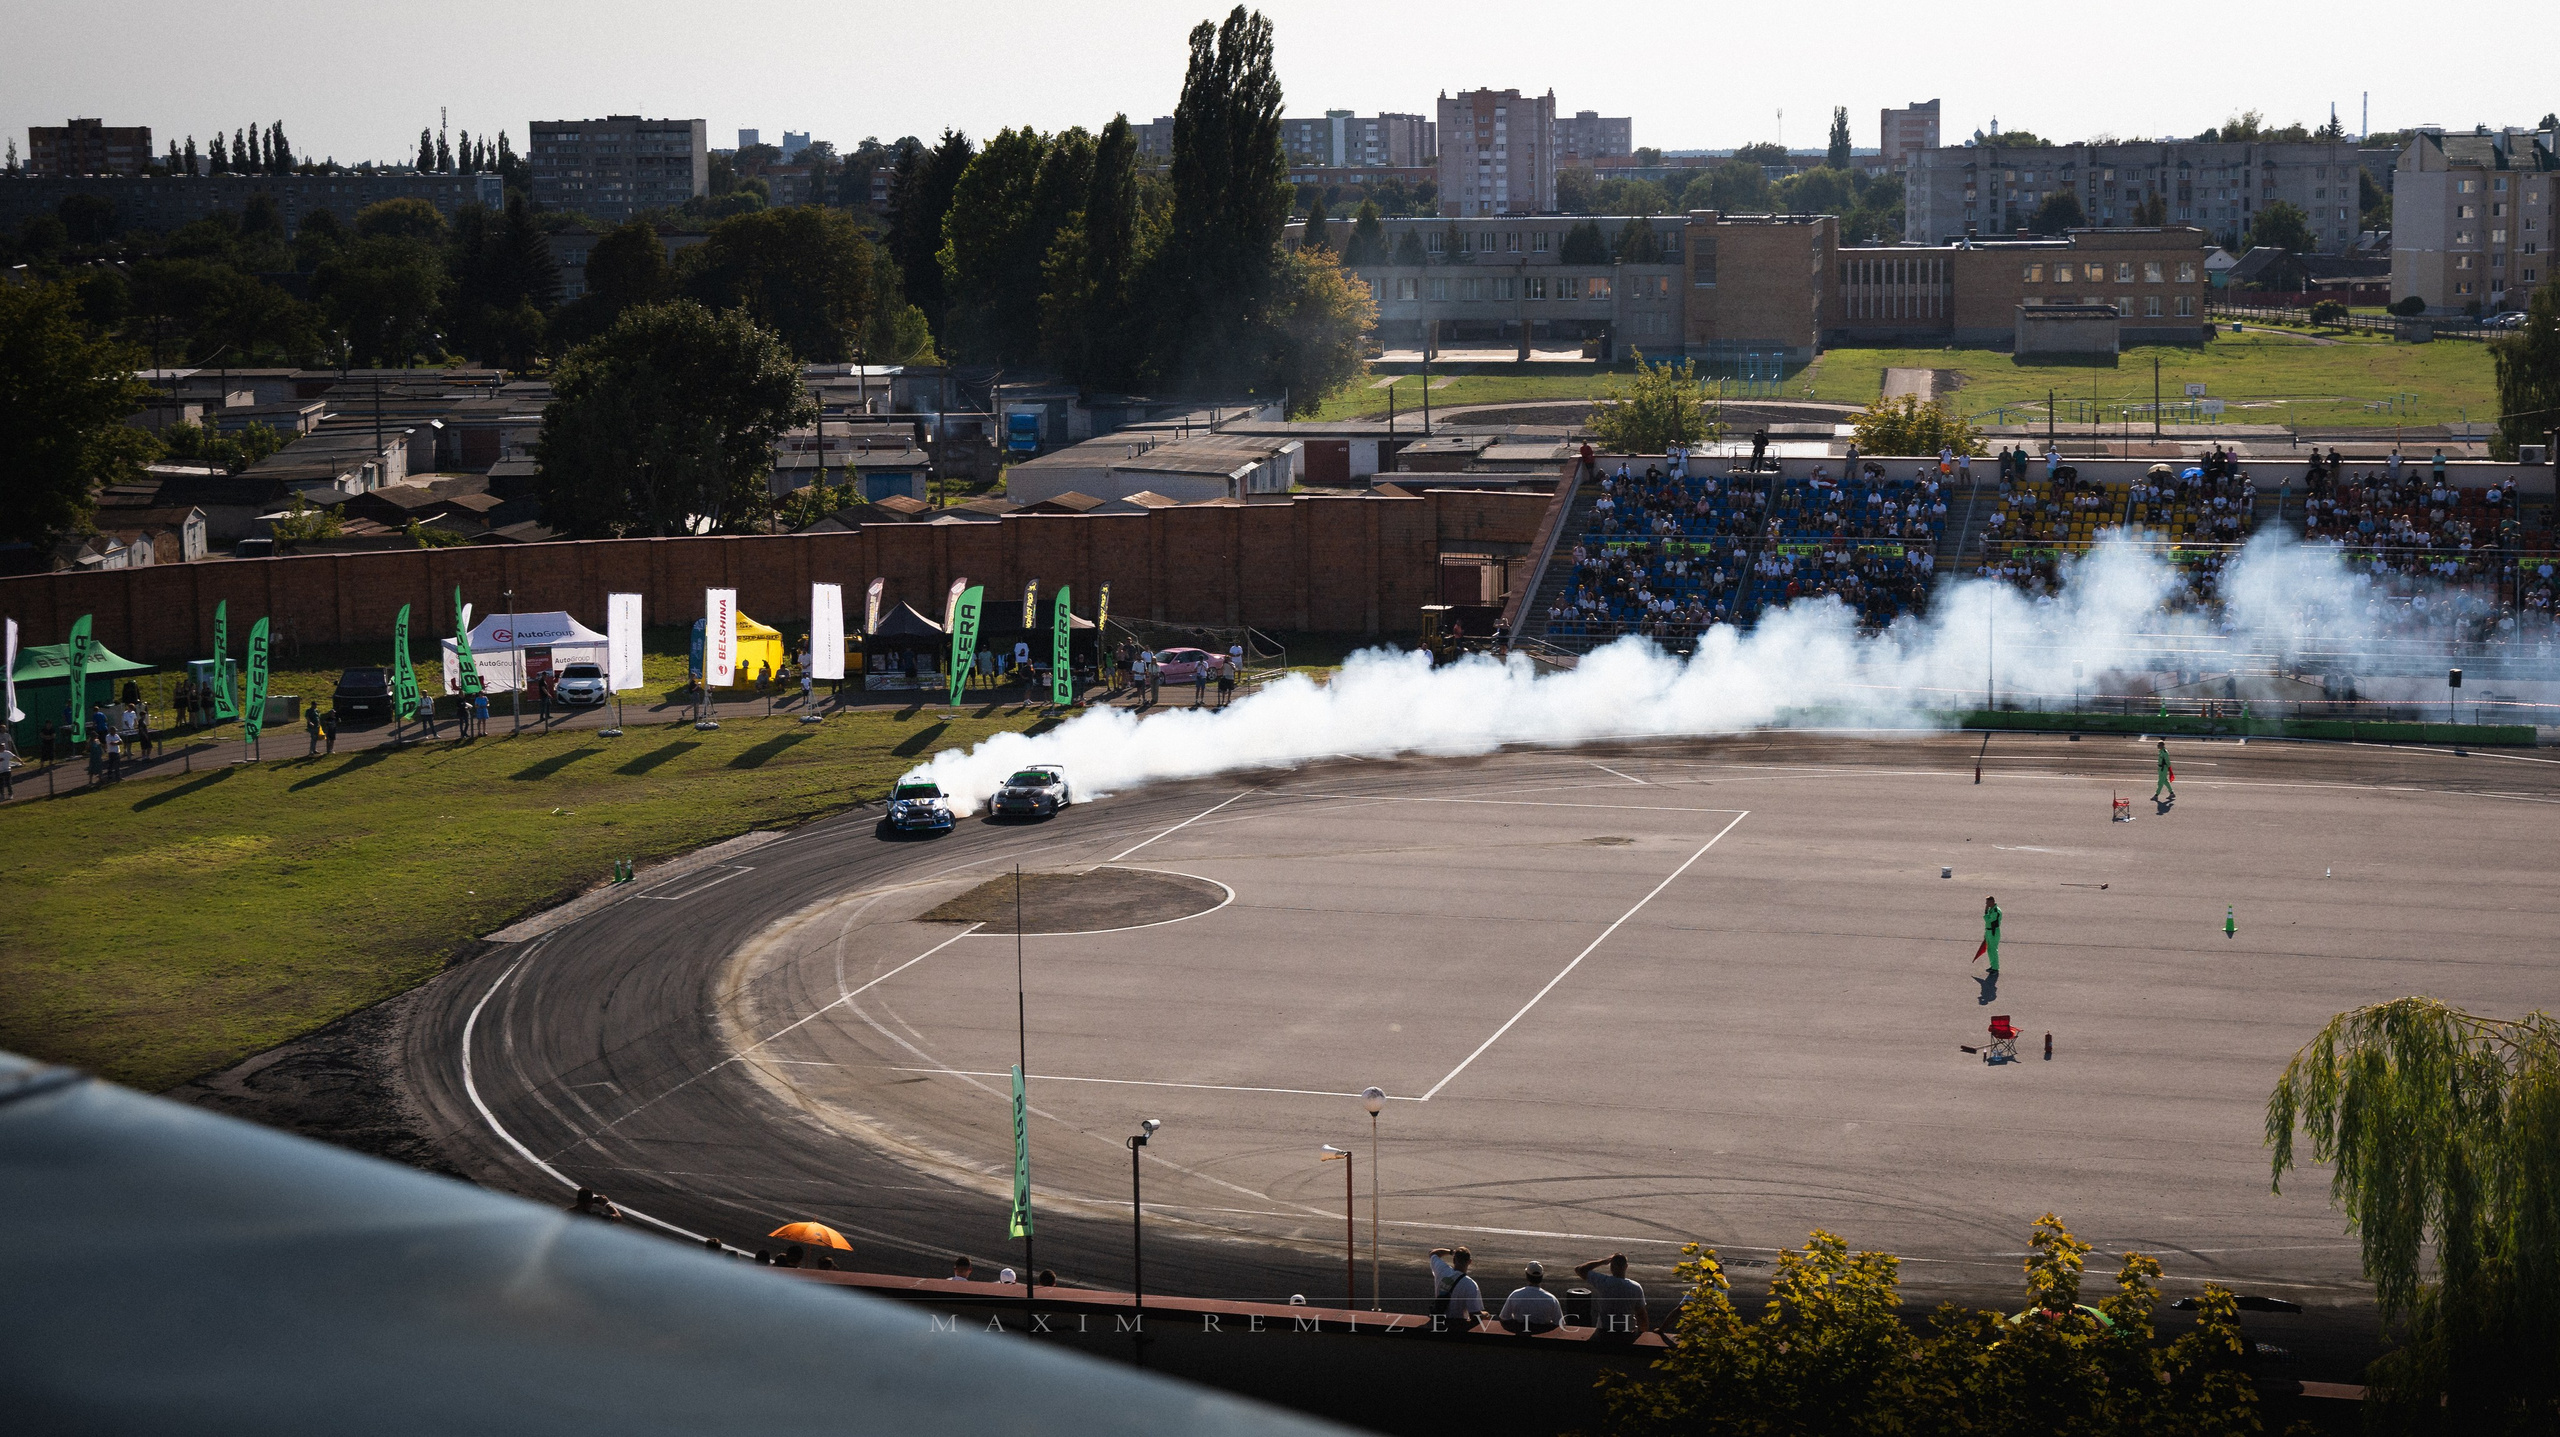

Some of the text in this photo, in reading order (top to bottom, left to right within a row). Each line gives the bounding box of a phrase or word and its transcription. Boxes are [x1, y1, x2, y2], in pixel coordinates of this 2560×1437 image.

[517, 629, 576, 640] AutoGroup
[718, 599, 727, 660] BELSHINA
[37, 653, 108, 669] BETRA
[479, 659, 515, 668] AutoGrou
[555, 655, 591, 665] AutoGroup
[247, 636, 267, 741] BETERA
